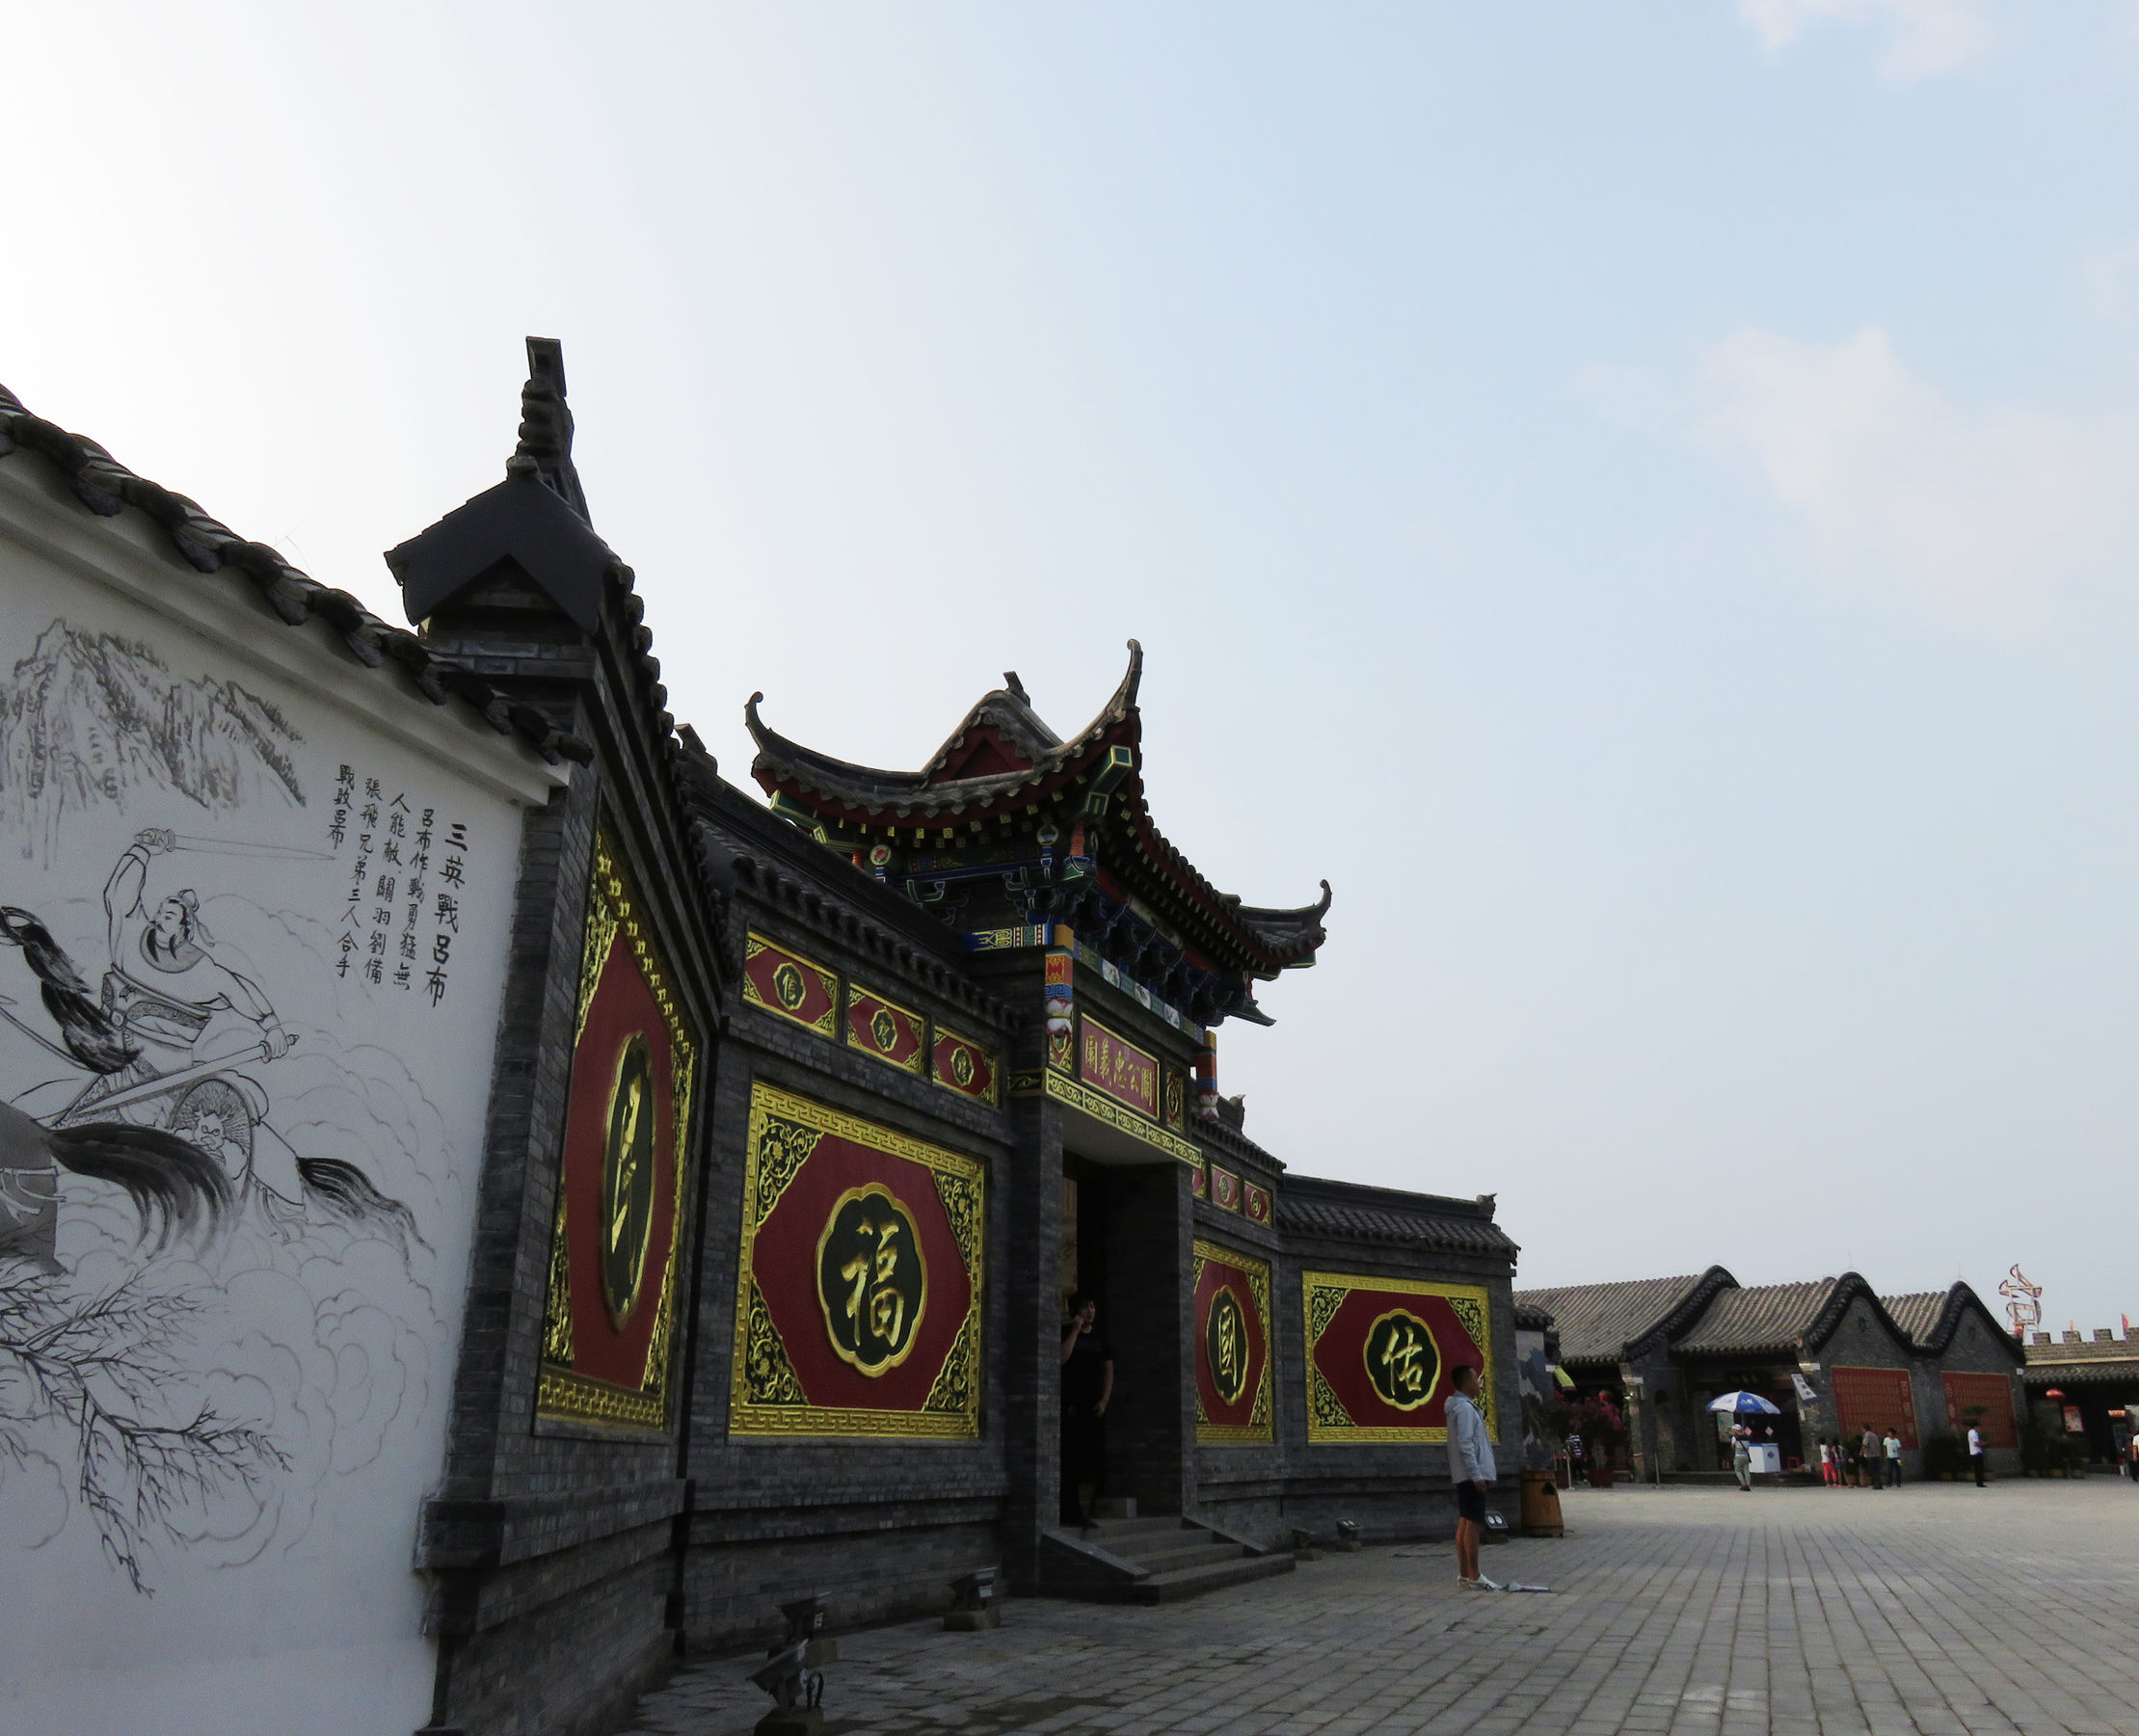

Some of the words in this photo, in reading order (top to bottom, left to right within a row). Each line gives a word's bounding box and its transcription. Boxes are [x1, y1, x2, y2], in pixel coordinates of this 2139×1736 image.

[424, 823, 468, 1007] 三英戰呂布
[782, 971, 796, 1002] 信
[841, 1216, 904, 1347] 福
[1217, 1304, 1238, 1386] 國
[1381, 1323, 1424, 1396] 佑
